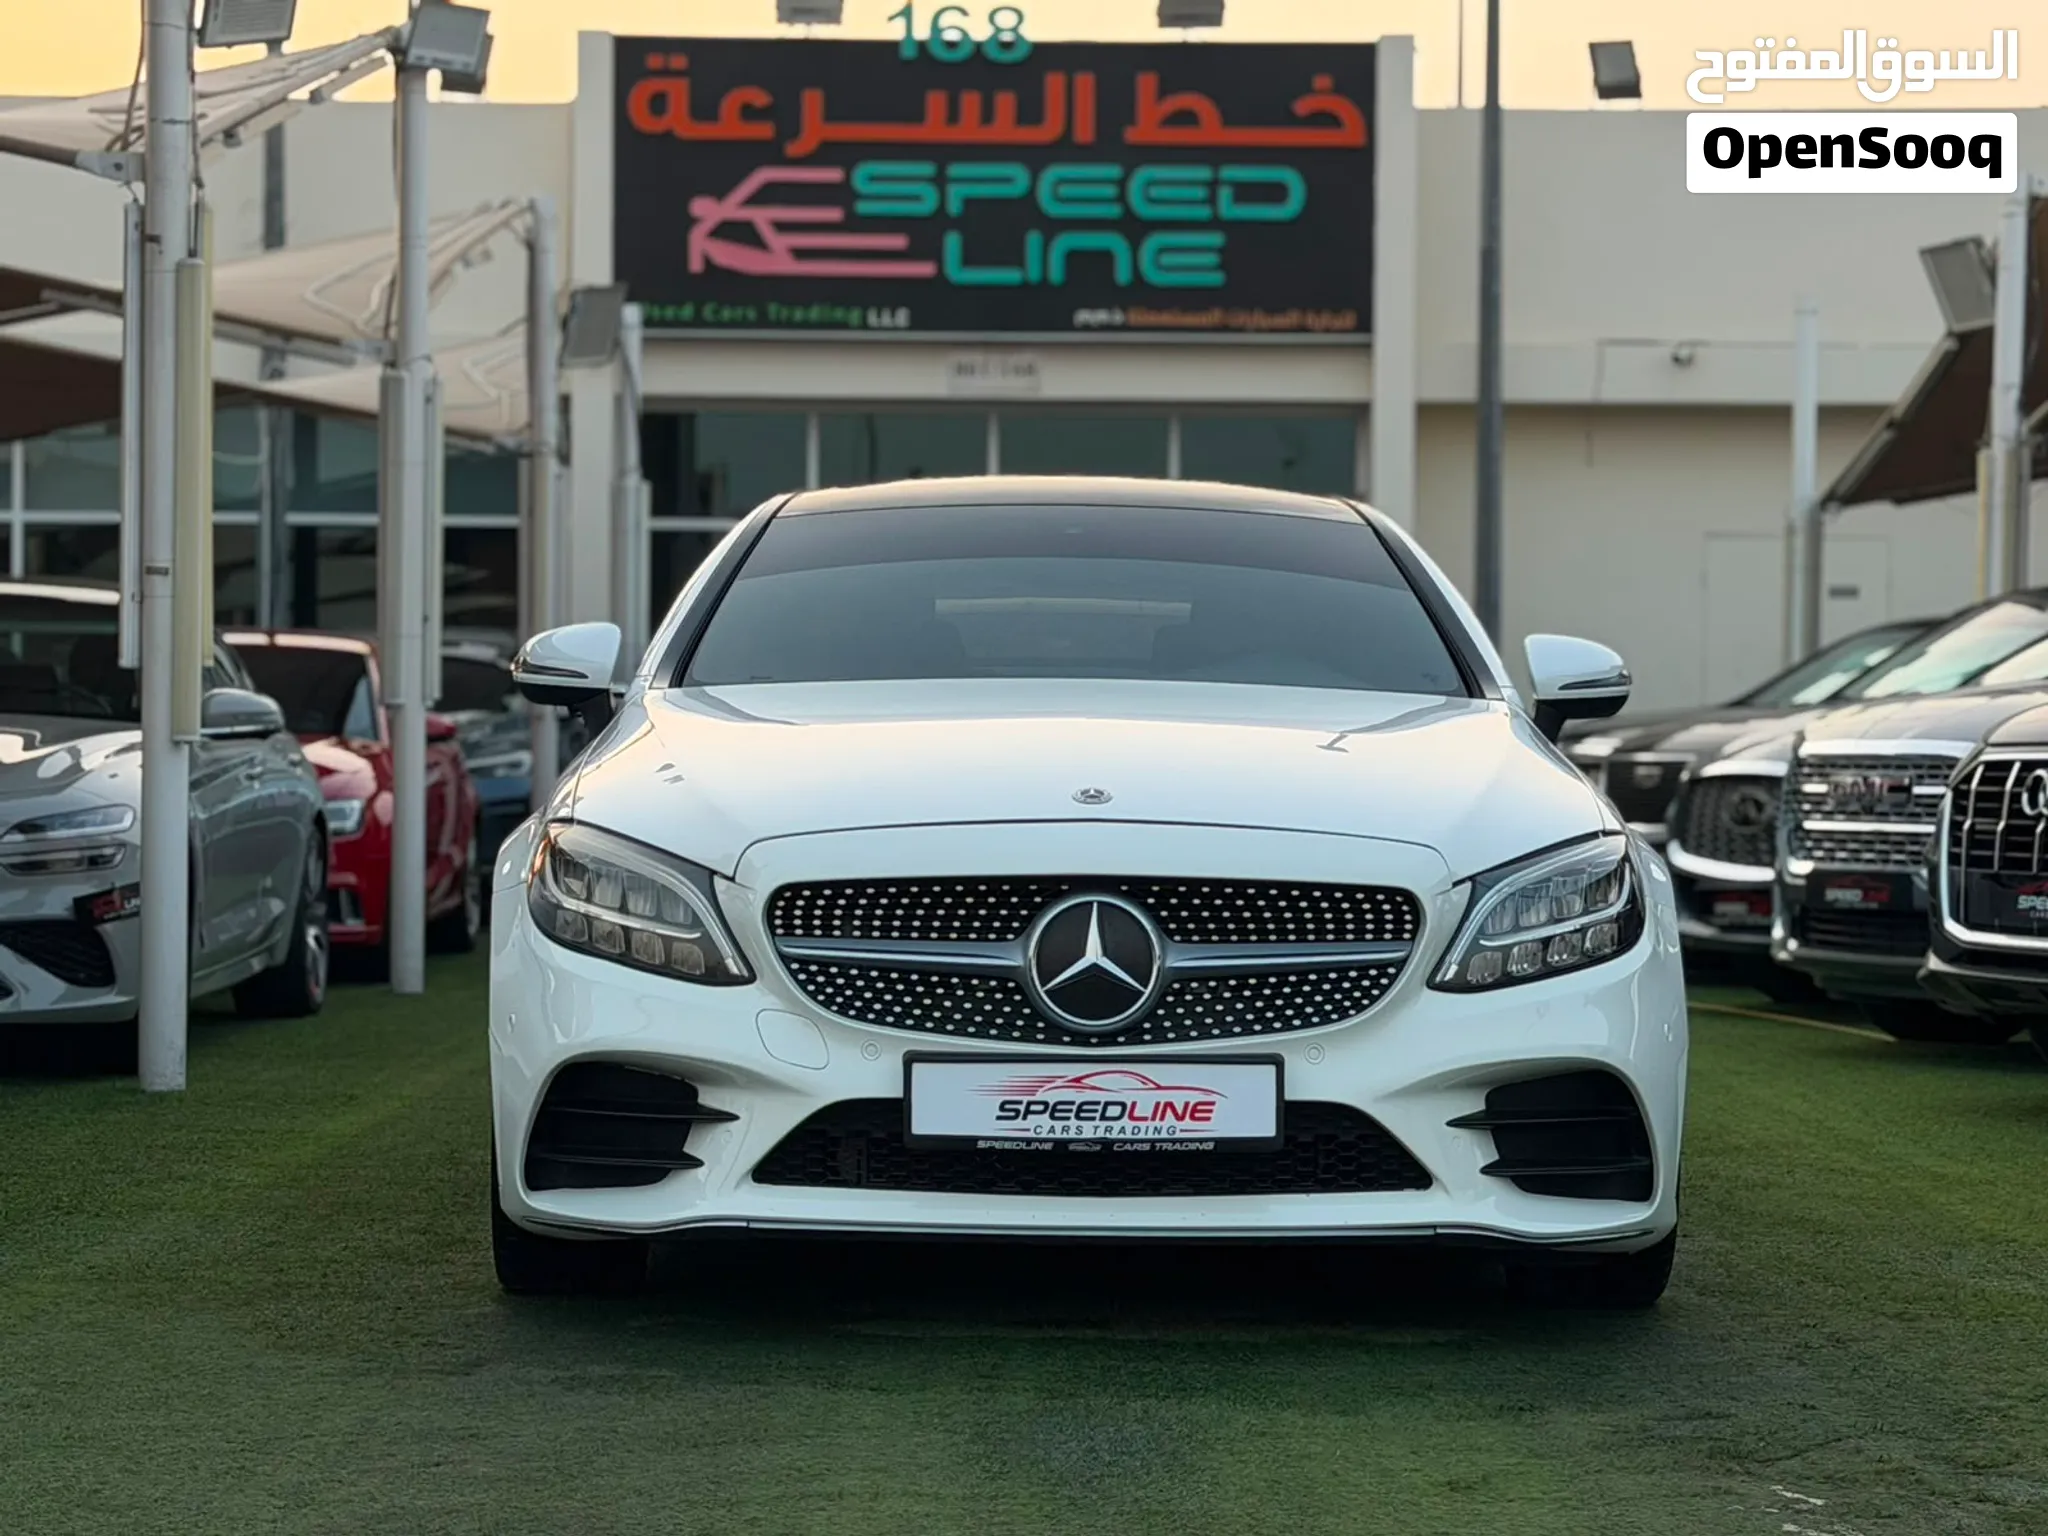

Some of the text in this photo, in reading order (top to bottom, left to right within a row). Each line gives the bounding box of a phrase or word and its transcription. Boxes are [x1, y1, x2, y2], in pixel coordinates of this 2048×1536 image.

[887, 2, 1034, 64] 168
[627, 54, 1367, 158] خط السرعة
[850, 160, 1308, 223] SPEED
[943, 230, 1227, 288] LINE
[995, 1100, 1217, 1122] SPEEDLINE
[1033, 1125, 1178, 1137] CARS TRADING
[976, 1140, 1215, 1151] SPEEDLINE CARS TRADING
